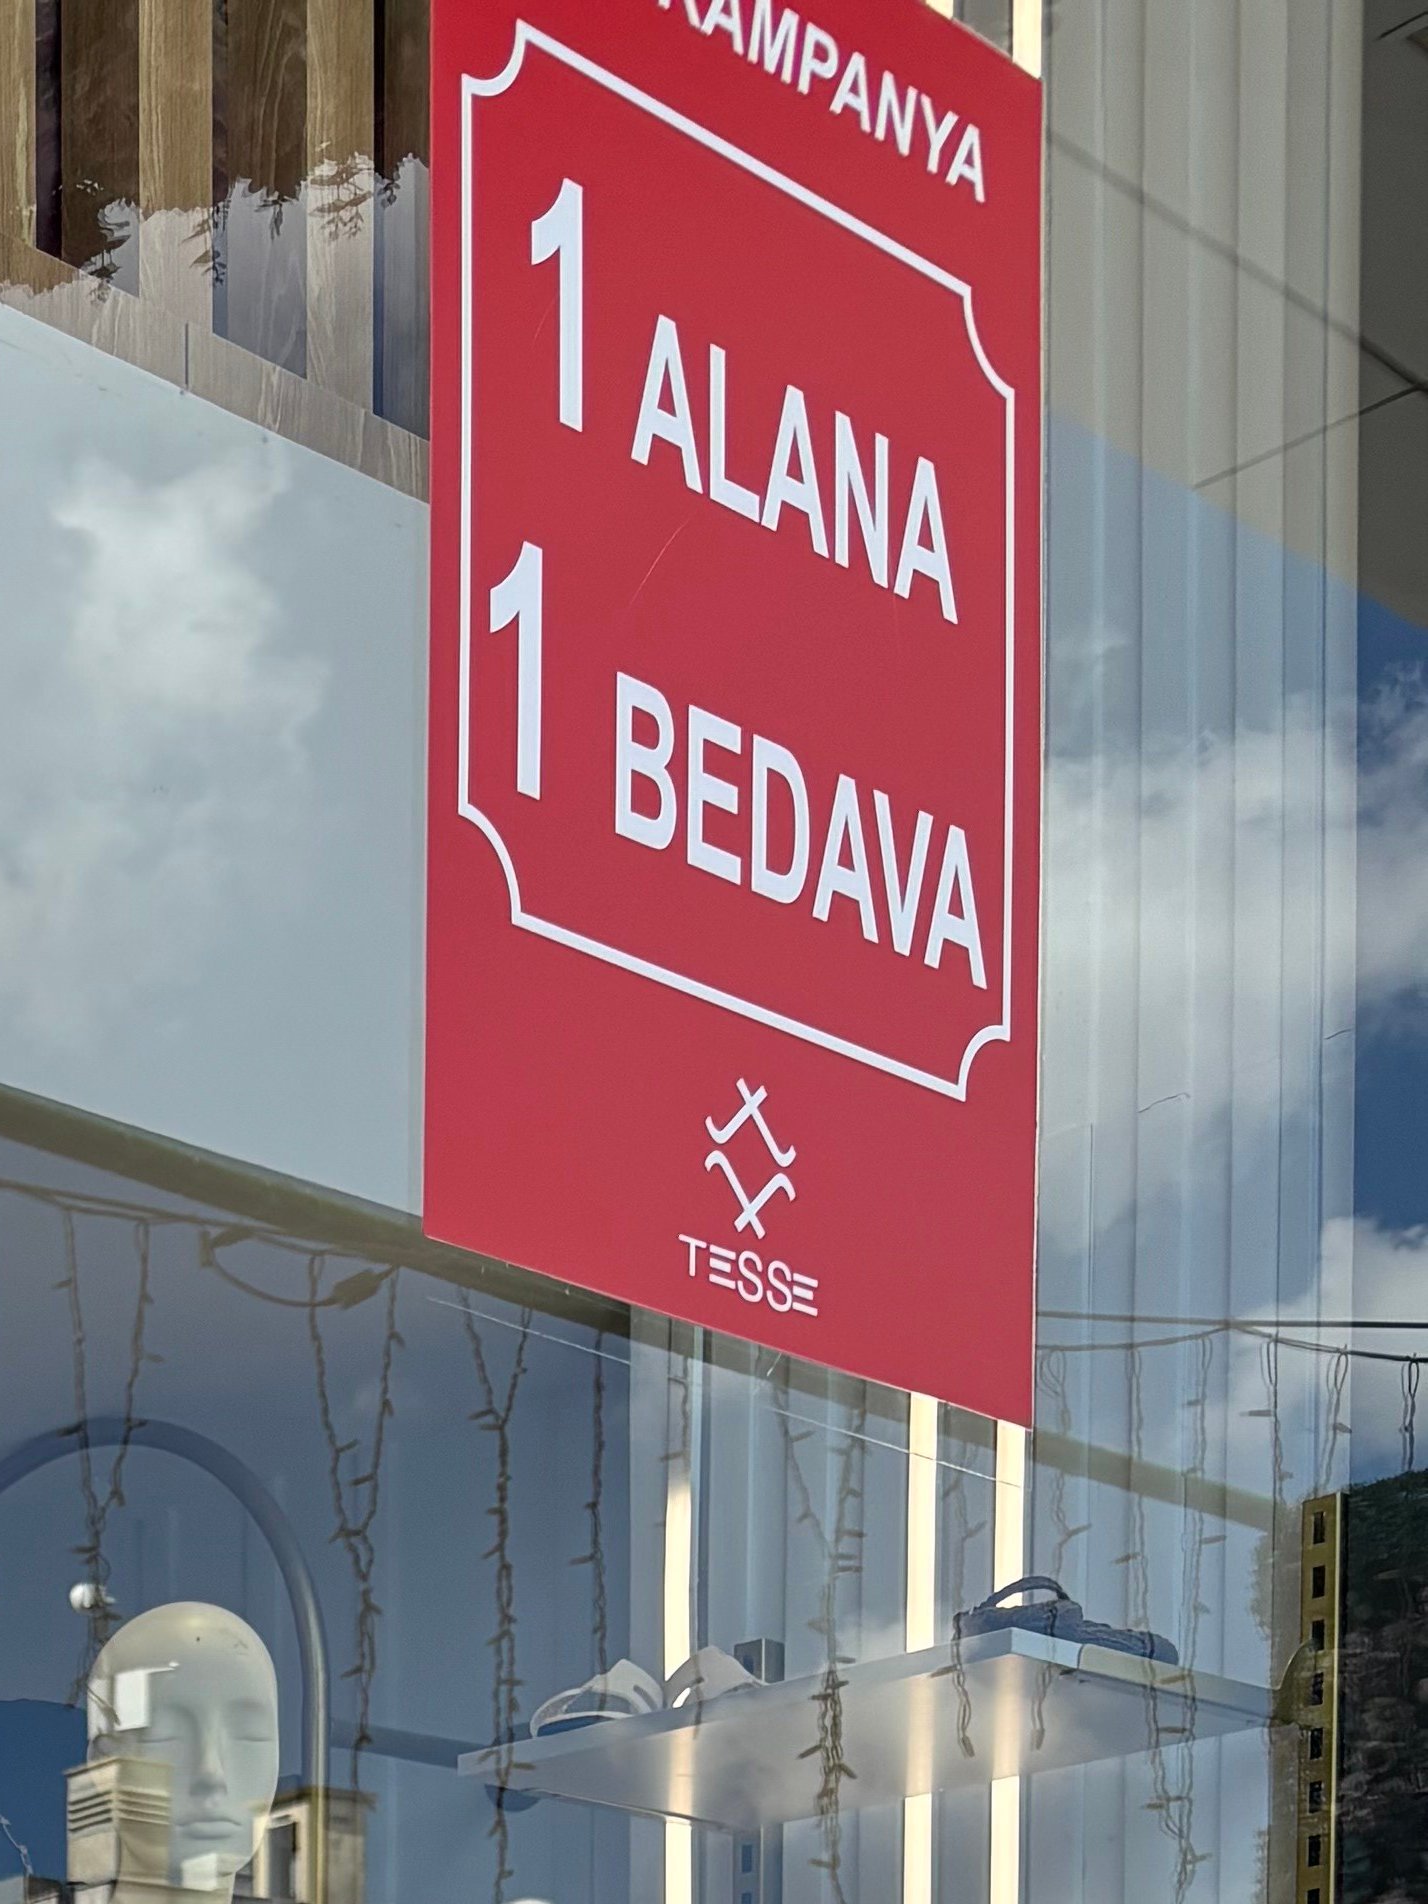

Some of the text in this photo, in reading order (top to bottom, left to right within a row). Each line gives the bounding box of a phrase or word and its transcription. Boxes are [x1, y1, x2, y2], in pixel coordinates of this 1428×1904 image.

[531, 178, 959, 625] 1 ALANA
[489, 540, 988, 990] 1 BEDAVA
[677, 1233, 819, 1317] TESSE
